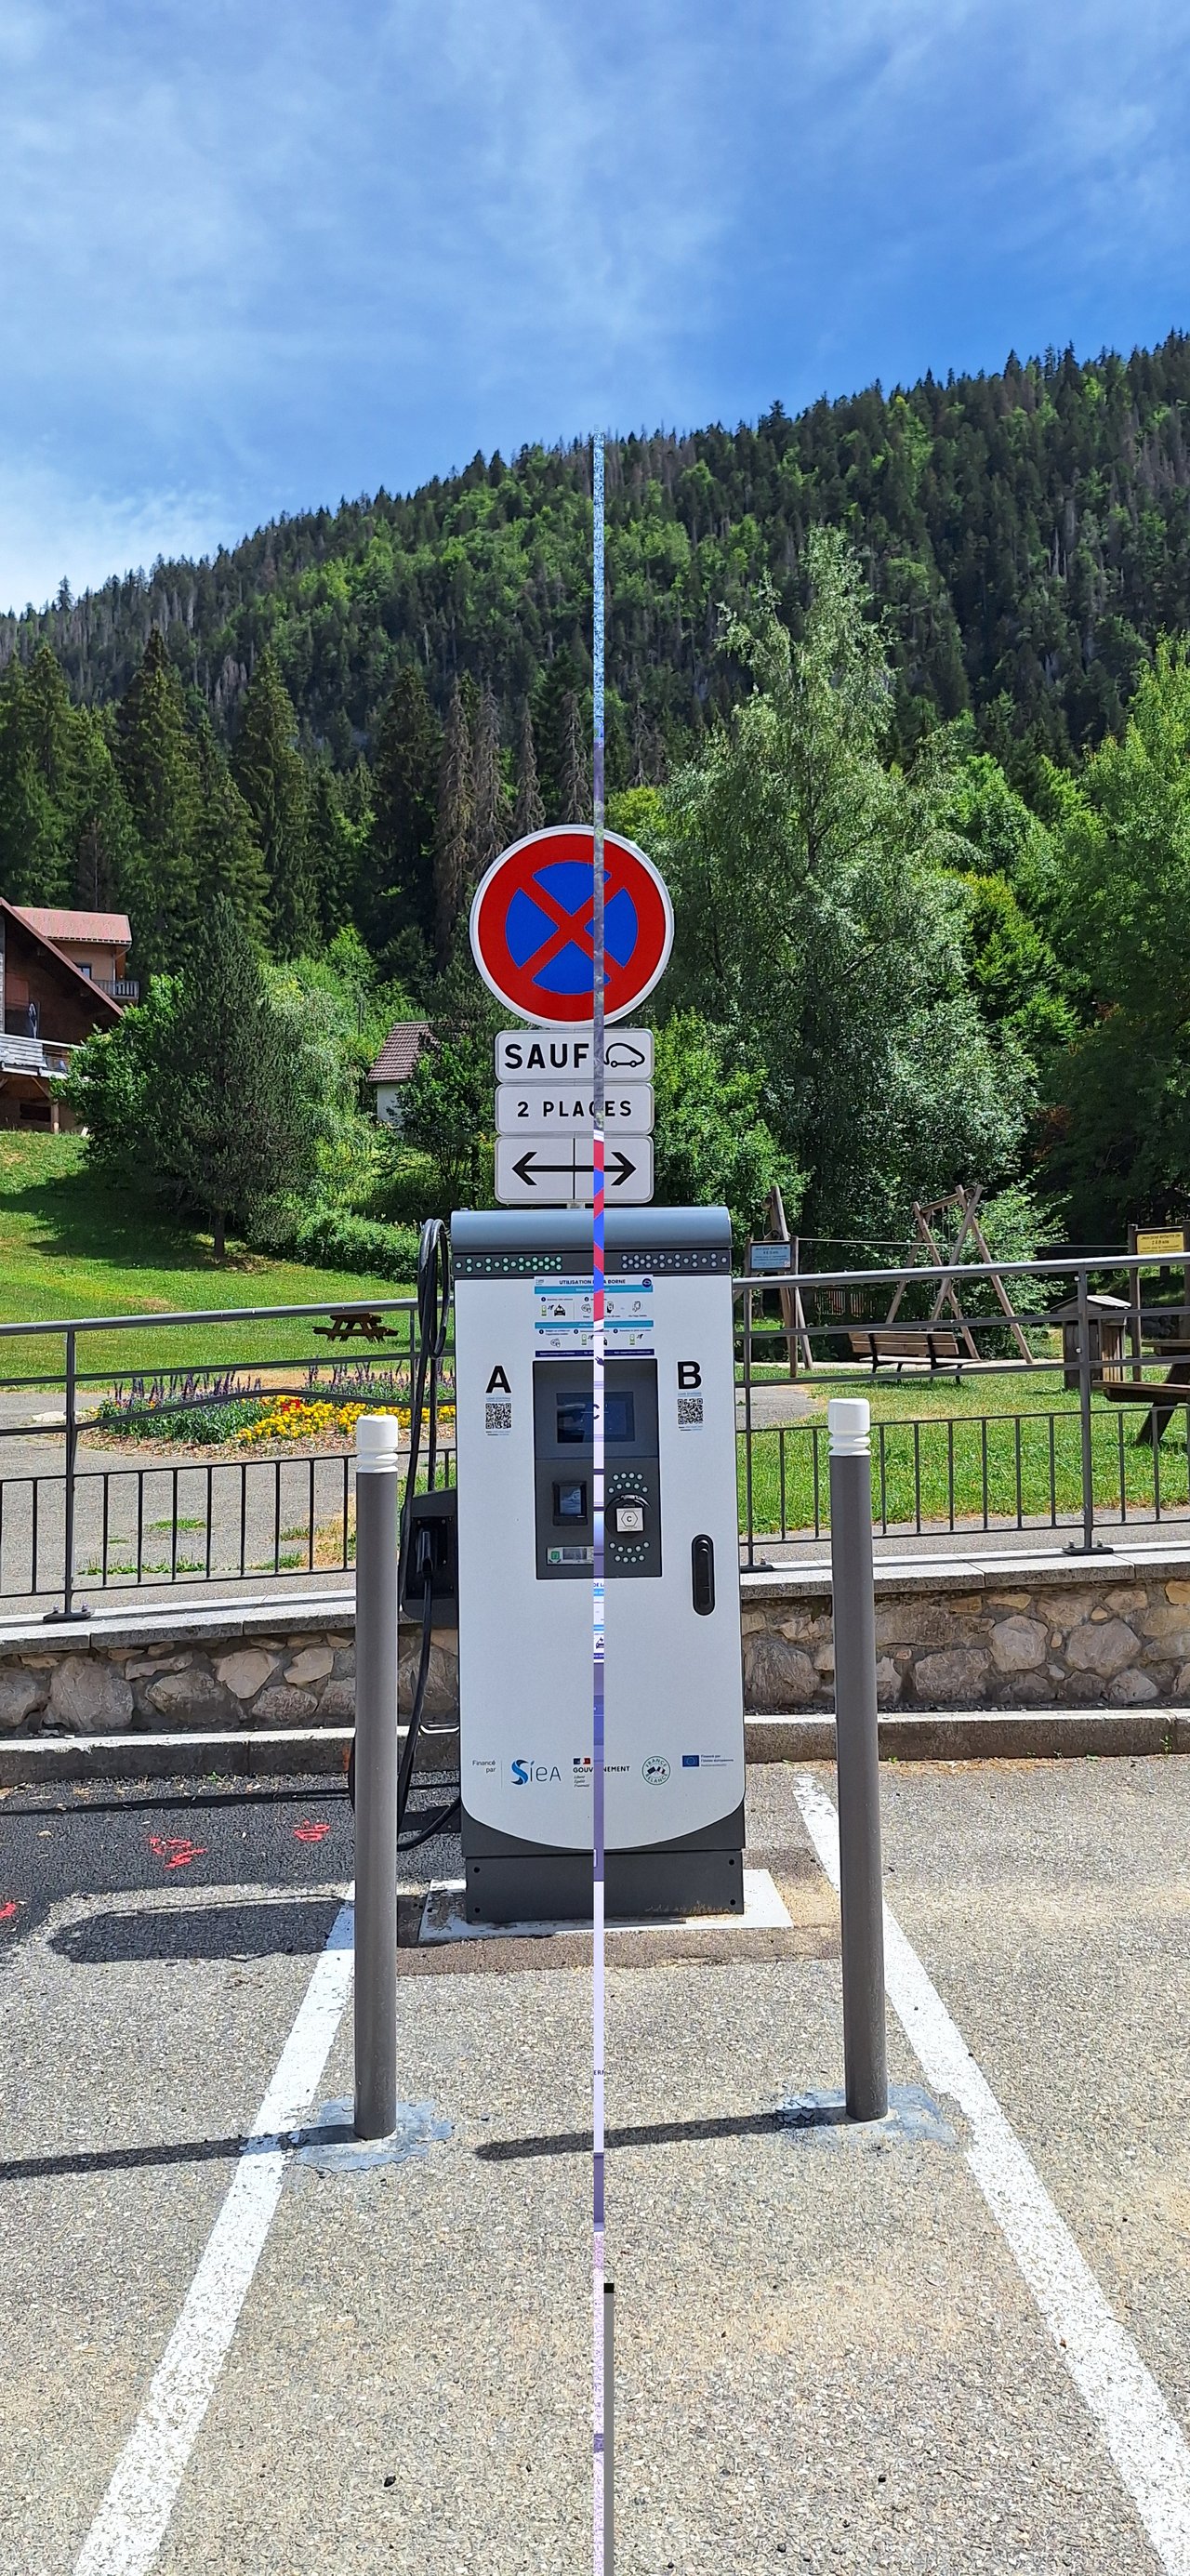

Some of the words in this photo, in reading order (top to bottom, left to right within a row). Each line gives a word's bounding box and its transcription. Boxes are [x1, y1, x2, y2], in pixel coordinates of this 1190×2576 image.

[505, 1043, 589, 1069] SAUF
[517, 1101, 529, 1117] 2
[485, 1366, 512, 1394] A
[678, 1361, 702, 1389] B
[645, 1758, 668, 1767] FRANCE
[645, 1773, 668, 1783] RELANCE
